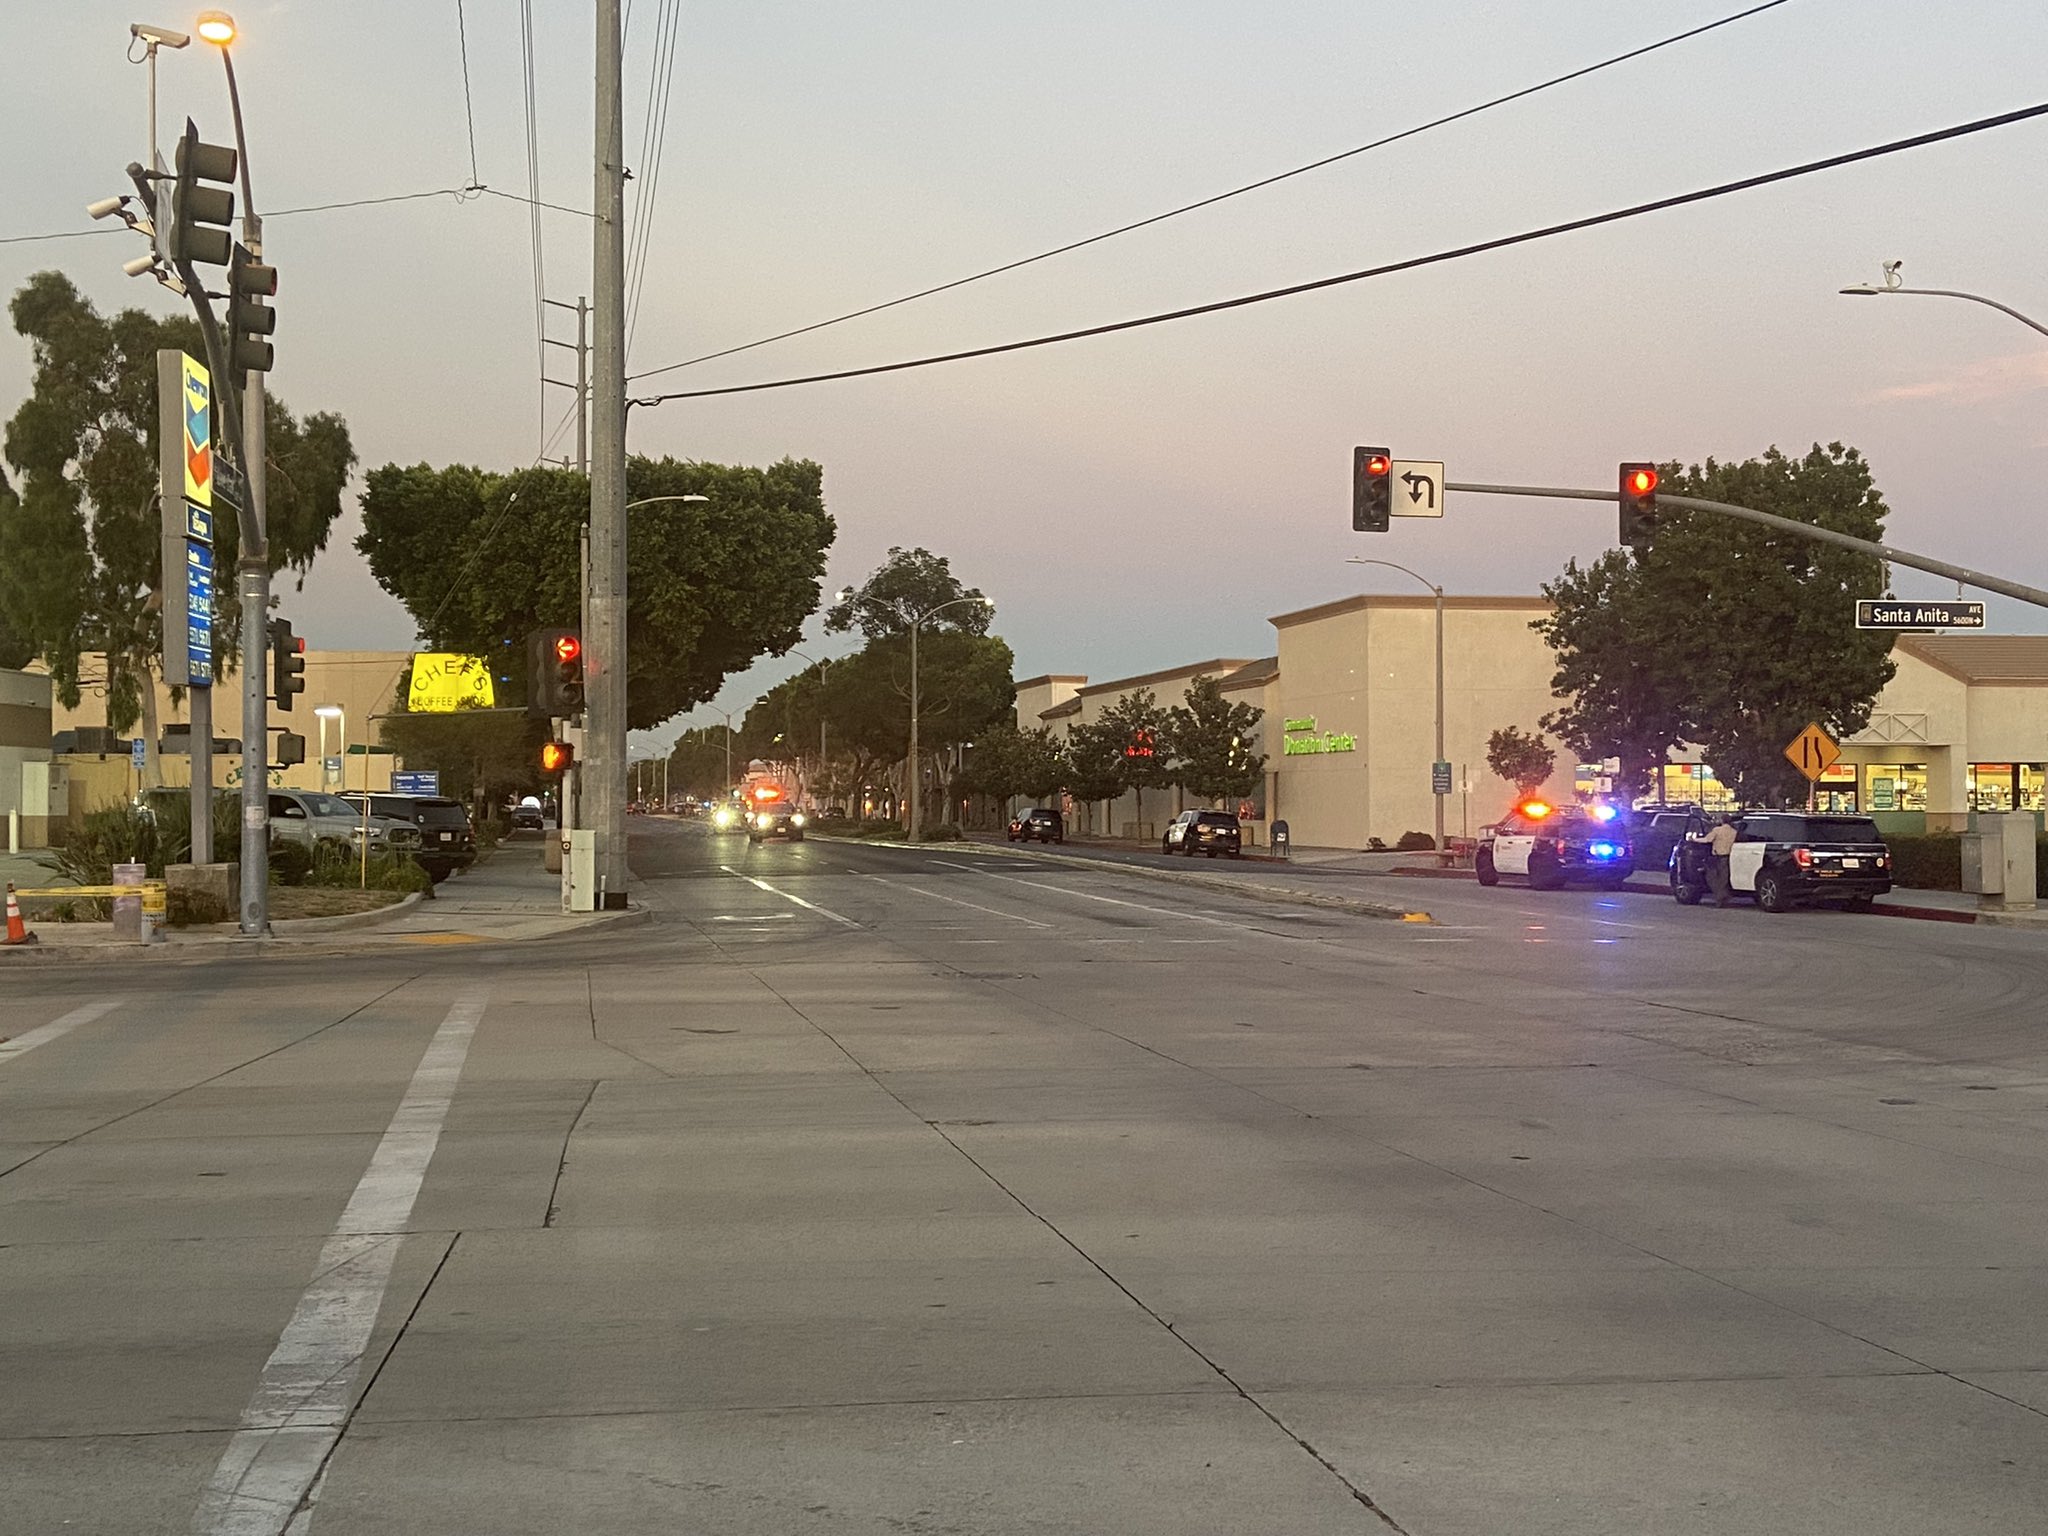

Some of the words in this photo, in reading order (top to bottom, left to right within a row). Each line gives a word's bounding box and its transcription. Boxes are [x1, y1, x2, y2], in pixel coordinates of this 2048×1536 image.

[1873, 608, 1911, 623] Santa
[1915, 608, 1949, 623] Anita
[1324, 731, 1356, 752] Center
